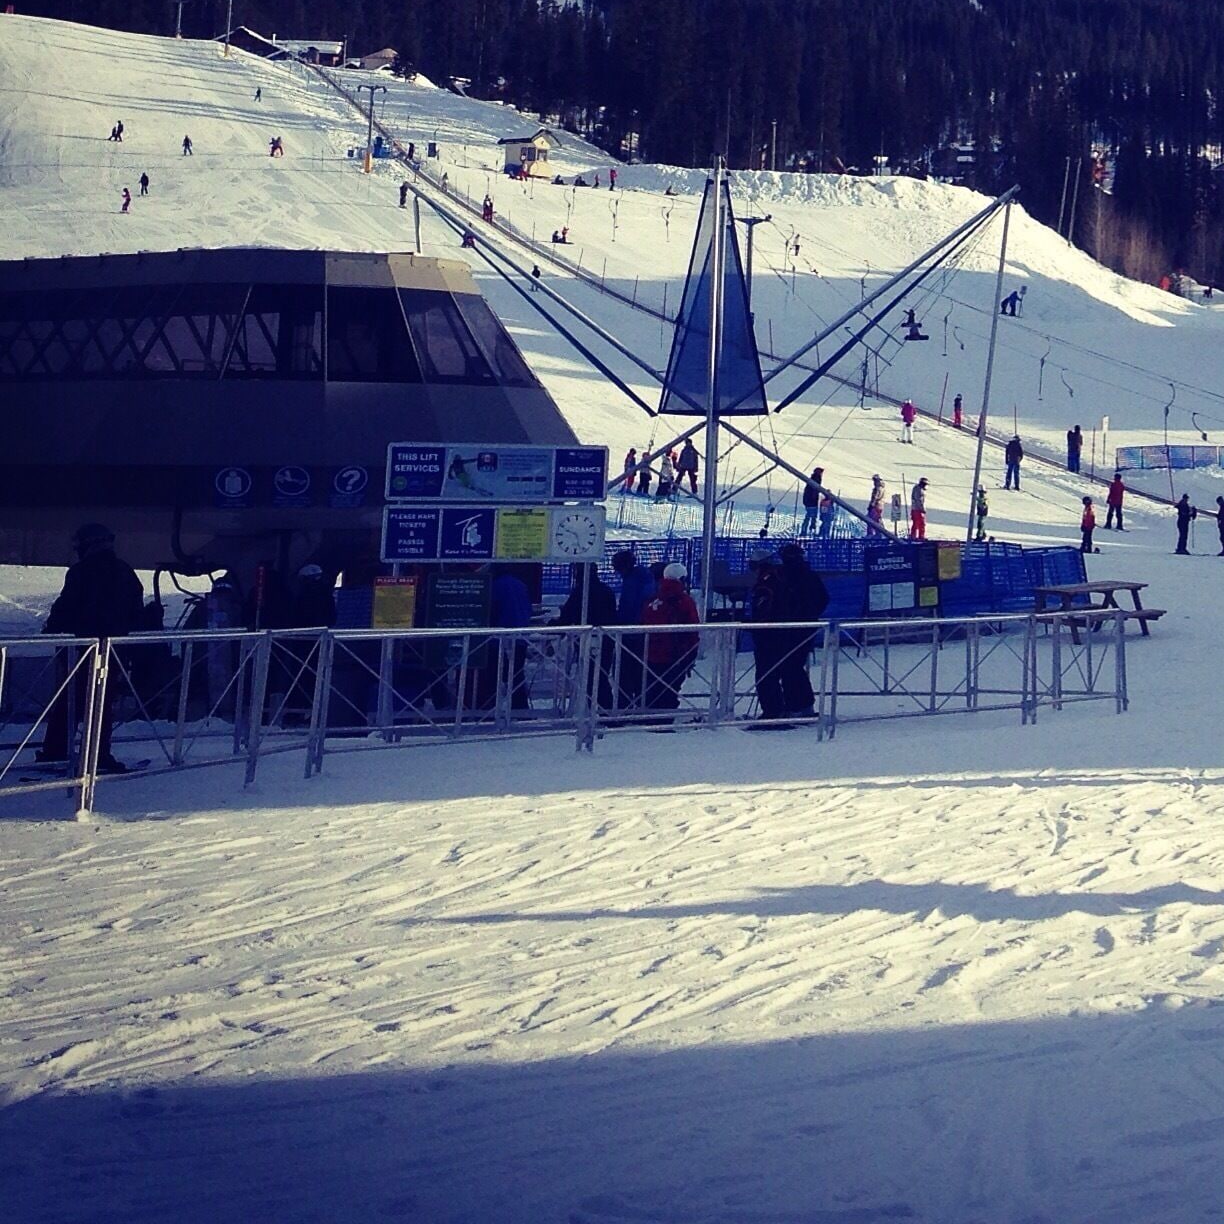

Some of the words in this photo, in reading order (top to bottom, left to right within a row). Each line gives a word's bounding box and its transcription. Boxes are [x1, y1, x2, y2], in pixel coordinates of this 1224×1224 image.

[397, 452, 418, 461] THIS
[420, 453, 439, 461] LIFT
[394, 464, 440, 473] SERVICES
